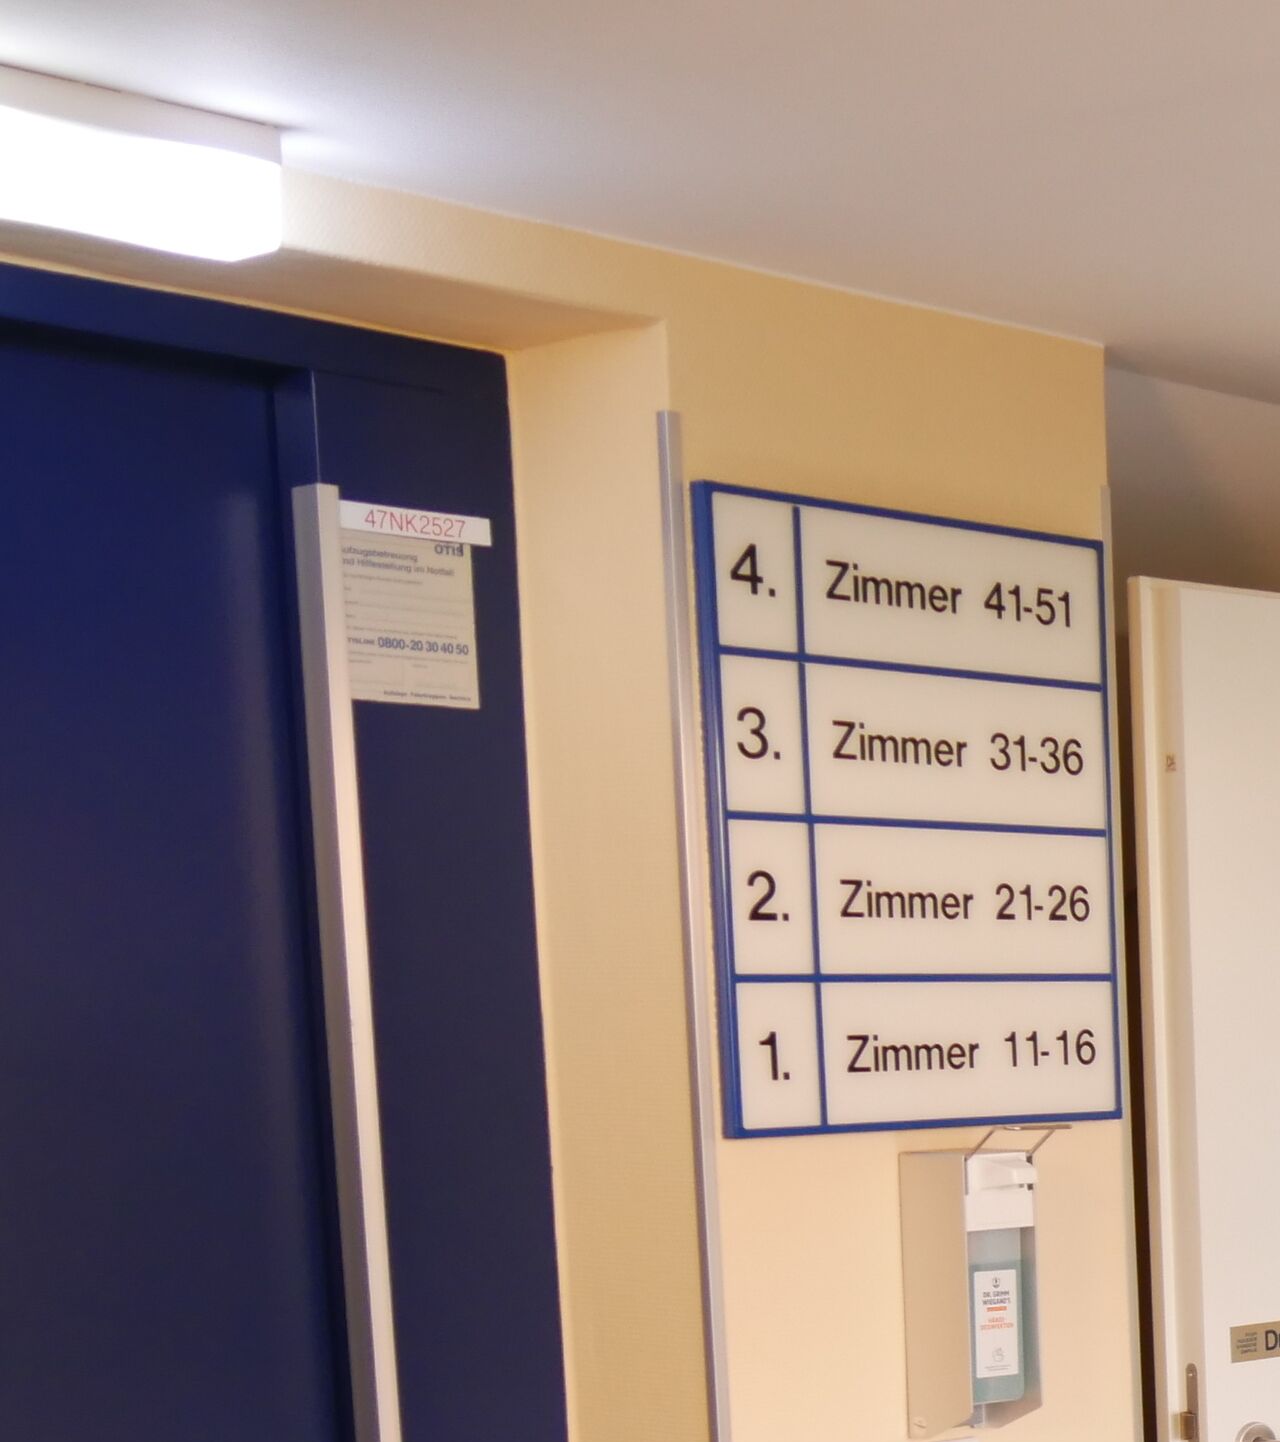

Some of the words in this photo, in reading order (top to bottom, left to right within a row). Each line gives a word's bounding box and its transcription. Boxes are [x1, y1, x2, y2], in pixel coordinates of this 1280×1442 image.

[364, 509, 466, 539] 47NK2527
[731, 544, 776, 597] 4.
[825, 559, 962, 614] Zimmer
[983, 582, 1072, 628] 41-51
[737, 707, 781, 760] 3.
[832, 720, 967, 767] Zimmer
[990, 732, 1084, 776] 31-36
[747, 870, 789, 921] 2.
[840, 879, 974, 920] Zimmer
[995, 883, 1090, 922] 21-26
[759, 1031, 790, 1081] 1.
[847, 1034, 979, 1073] Zimmer
[1004, 1029, 1096, 1067] 11-16
